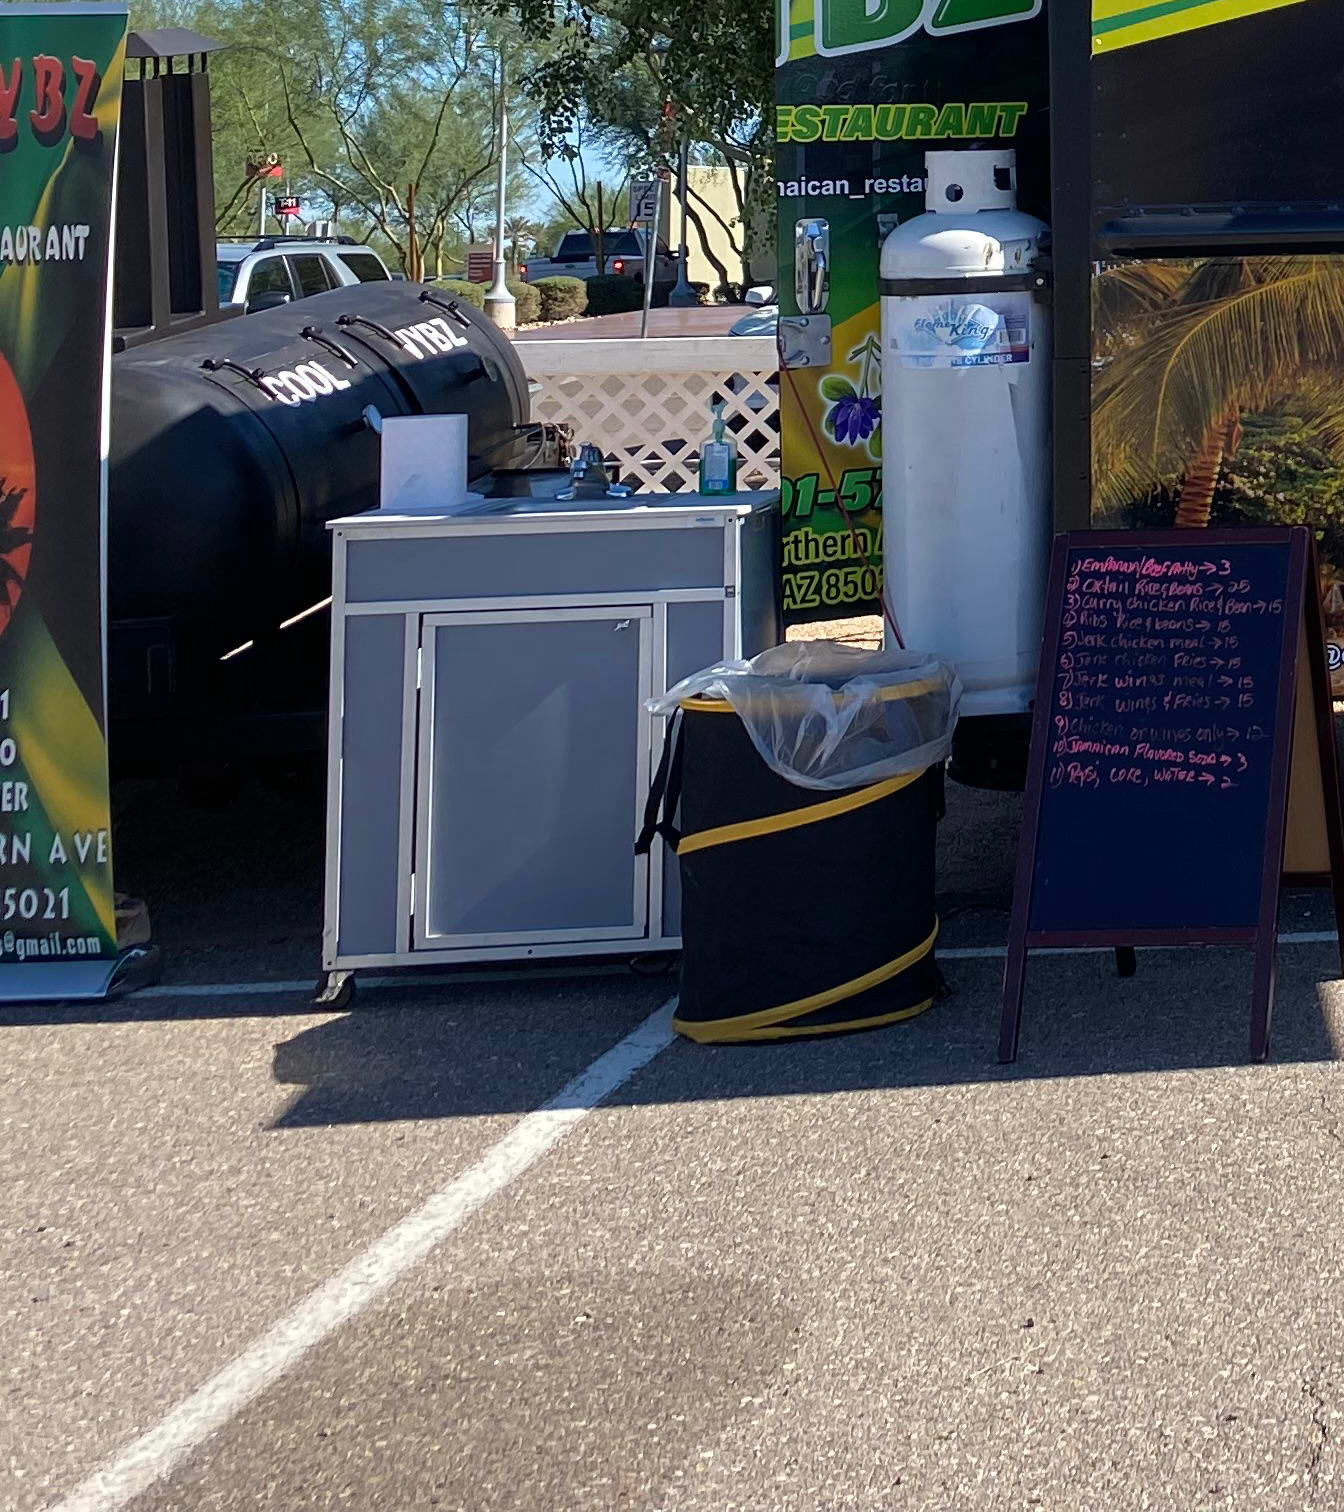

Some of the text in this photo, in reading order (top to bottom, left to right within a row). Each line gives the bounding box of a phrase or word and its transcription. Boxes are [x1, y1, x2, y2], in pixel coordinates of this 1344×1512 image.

[776, 173, 927, 199] aican_resta
[949, 323, 992, 340] King
[258, 360, 351, 408] COOL
[1218, 559, 1231, 575] 3
[822, 565, 883, 604] 850
[1227, 579, 1251, 594] 25
[1268, 598, 1284, 614] 15
[1224, 635, 1240, 649] 15
[1238, 676, 1254, 689] 15
[1238, 693, 1255, 709] 15
[1236, 751, 1248, 772] 3
[1219, 774, 1238, 790] 2
[49, 831, 108, 866] AVE
[3, 886, 70, 921] 5021
